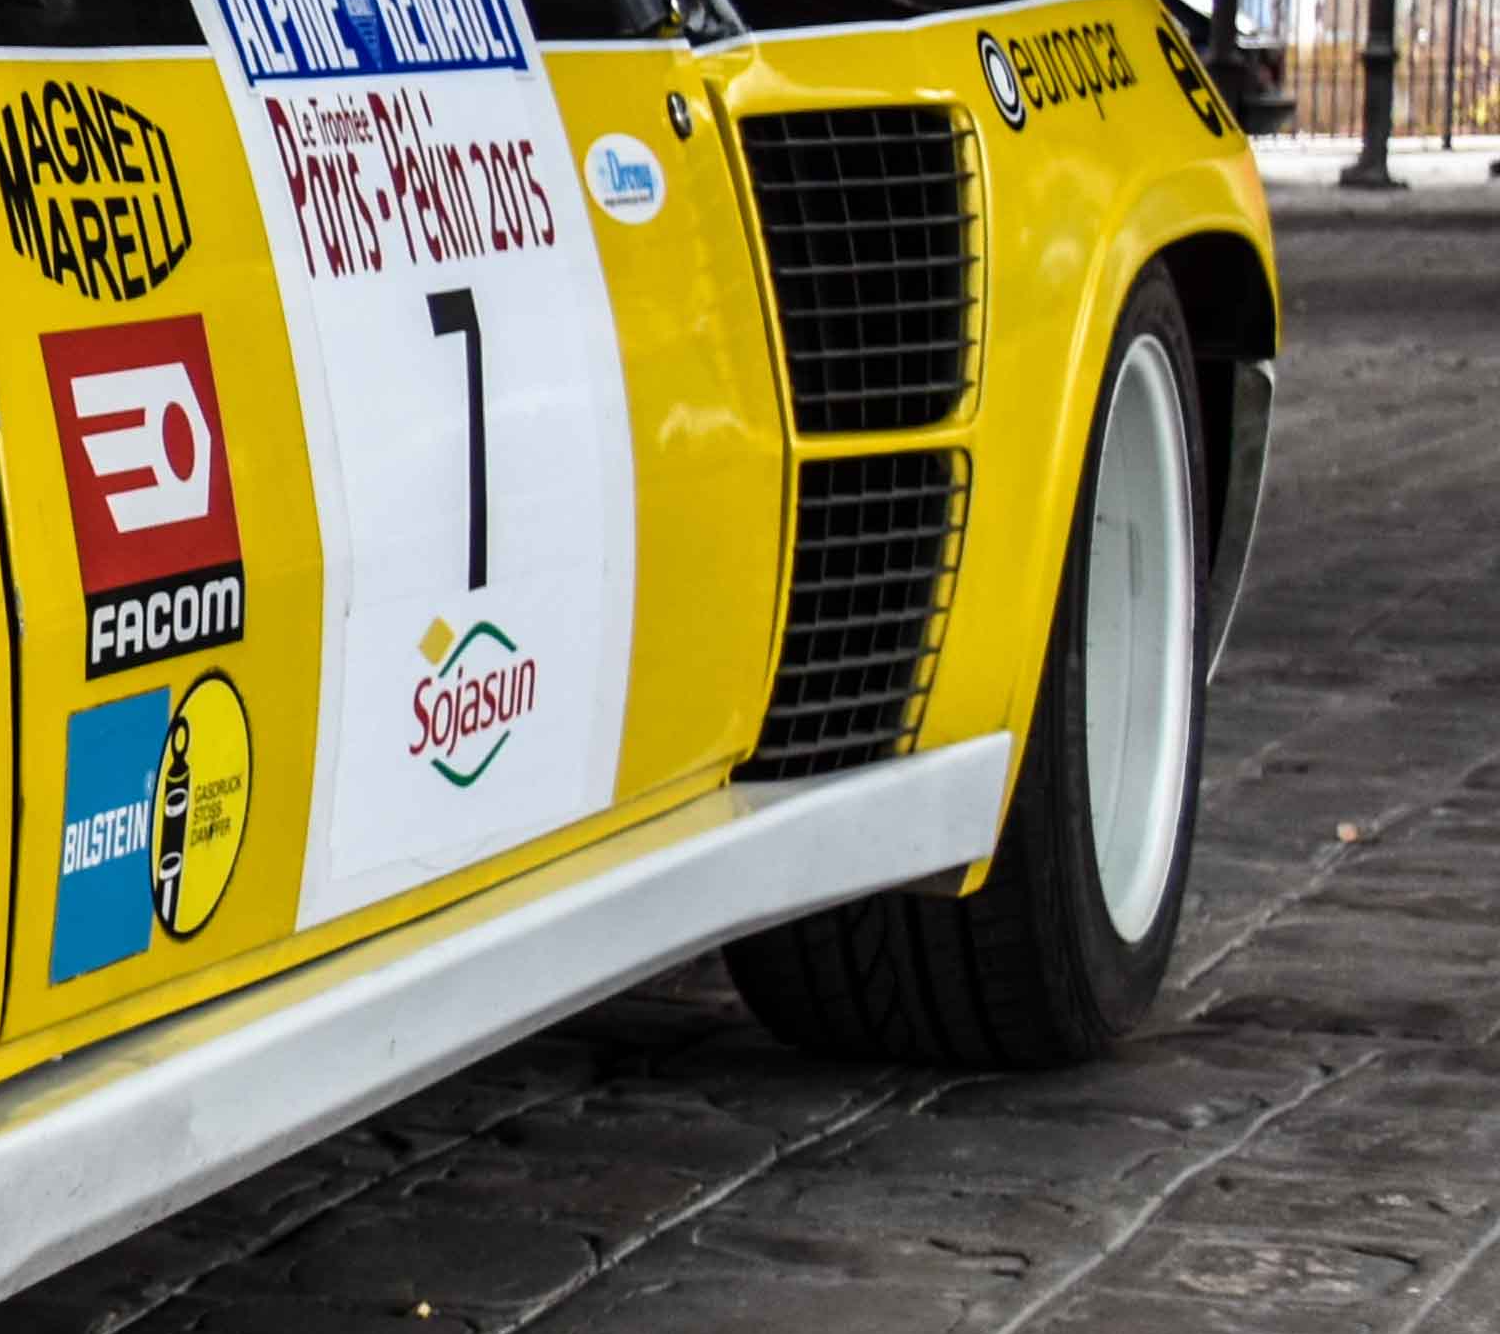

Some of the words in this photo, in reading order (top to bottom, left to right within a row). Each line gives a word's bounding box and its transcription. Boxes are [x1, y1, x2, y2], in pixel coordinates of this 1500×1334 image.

[1009, 20, 1136, 120] europcar
[290, 99, 317, 148] Le
[308, 93, 373, 150] Trophée
[265, 97, 382, 278] Paris
[367, 87, 485, 264] Pékin
[469, 140, 555, 252] 2015
[426, 287, 487, 591] 7
[90, 575, 242, 665] FACOM
[409, 658, 535, 758] Sojasun
[63, 799, 149, 875] BILSTEIN
